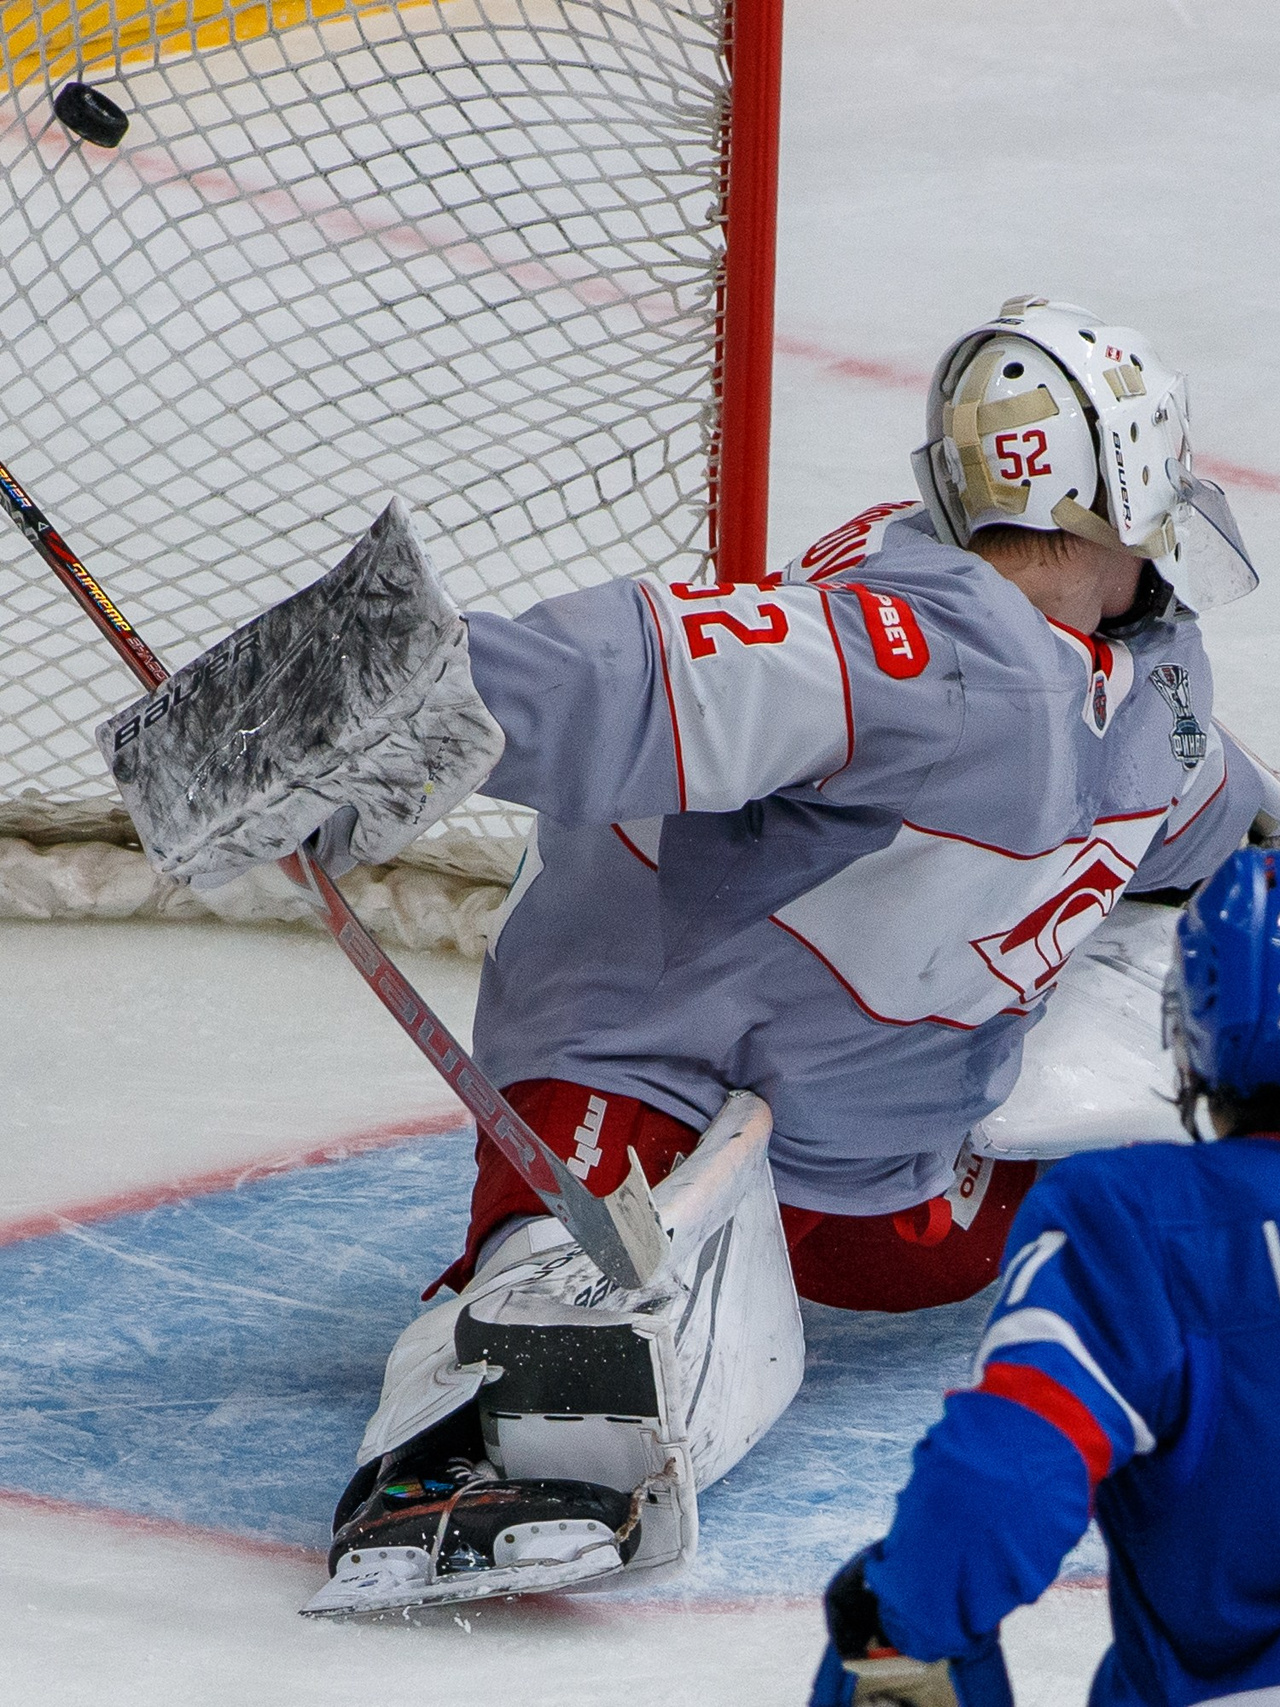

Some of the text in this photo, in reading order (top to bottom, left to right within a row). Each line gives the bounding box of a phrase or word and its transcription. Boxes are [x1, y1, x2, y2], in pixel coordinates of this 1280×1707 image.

[995, 429, 1053, 480] 52
[873, 592, 914, 660] PBET
[126, 636, 168, 682] SHADO
